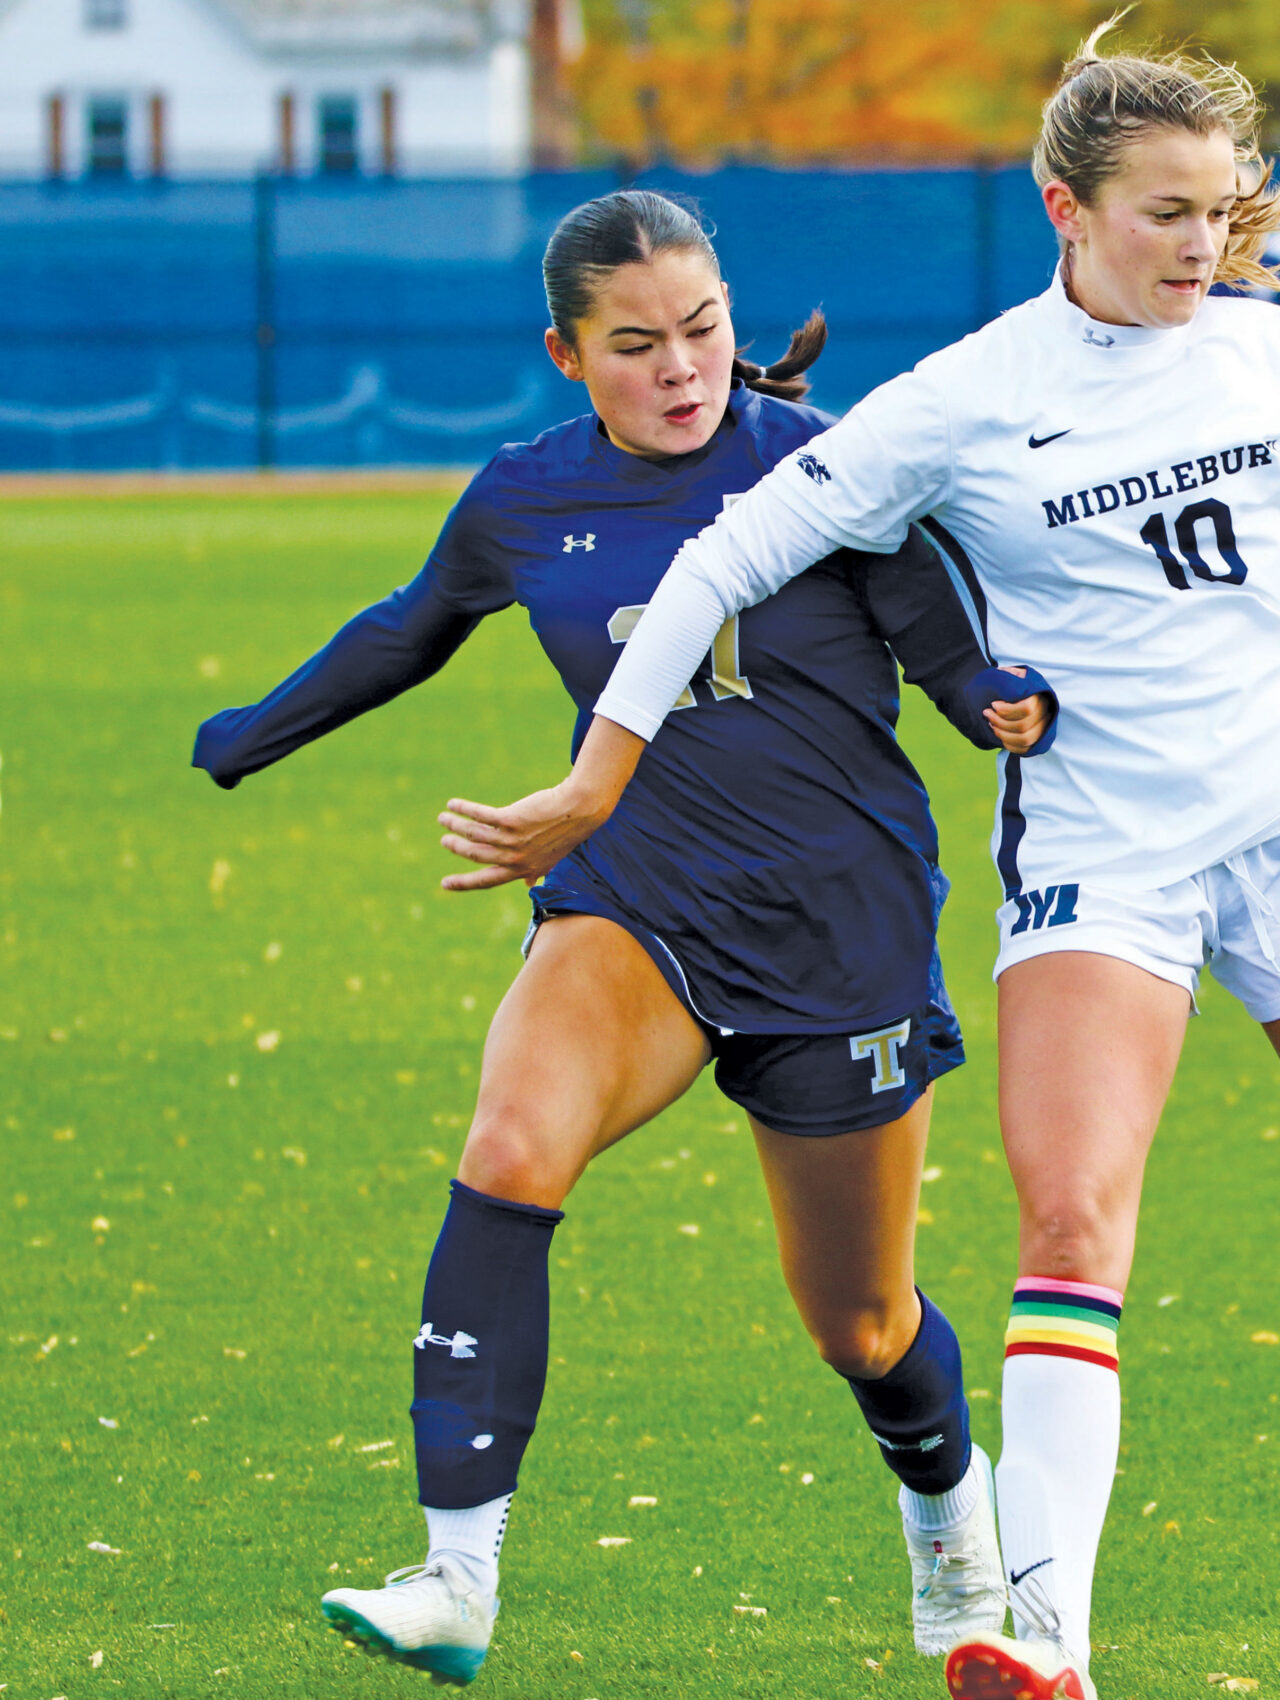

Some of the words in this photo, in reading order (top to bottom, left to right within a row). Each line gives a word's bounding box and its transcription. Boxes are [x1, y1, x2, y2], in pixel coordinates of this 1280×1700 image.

[1139, 497, 1249, 591] 10
[1010, 883, 1080, 937] M
[848, 1017, 911, 1095] T
